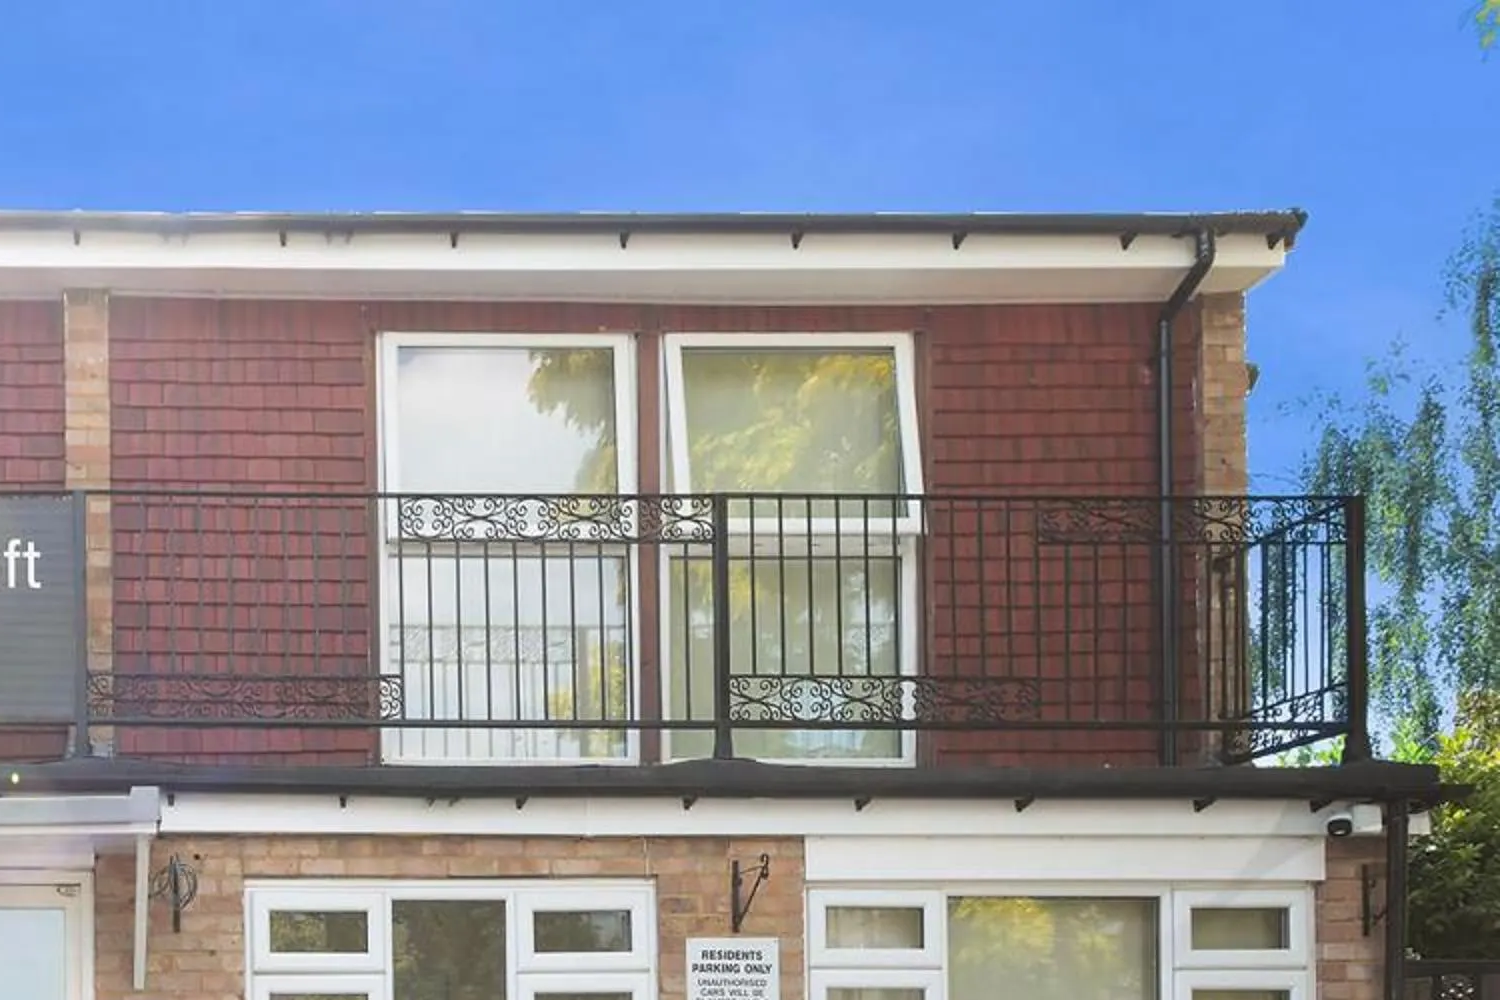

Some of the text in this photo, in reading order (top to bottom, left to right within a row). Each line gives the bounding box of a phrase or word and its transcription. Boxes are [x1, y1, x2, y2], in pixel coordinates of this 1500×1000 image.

[701, 949, 763, 961] RESIDENTS
[691, 963, 773, 975] PARKING ONLY
[696, 979, 768, 987] UNAUTHORISED
[699, 987, 764, 998] CARS WILL BE
